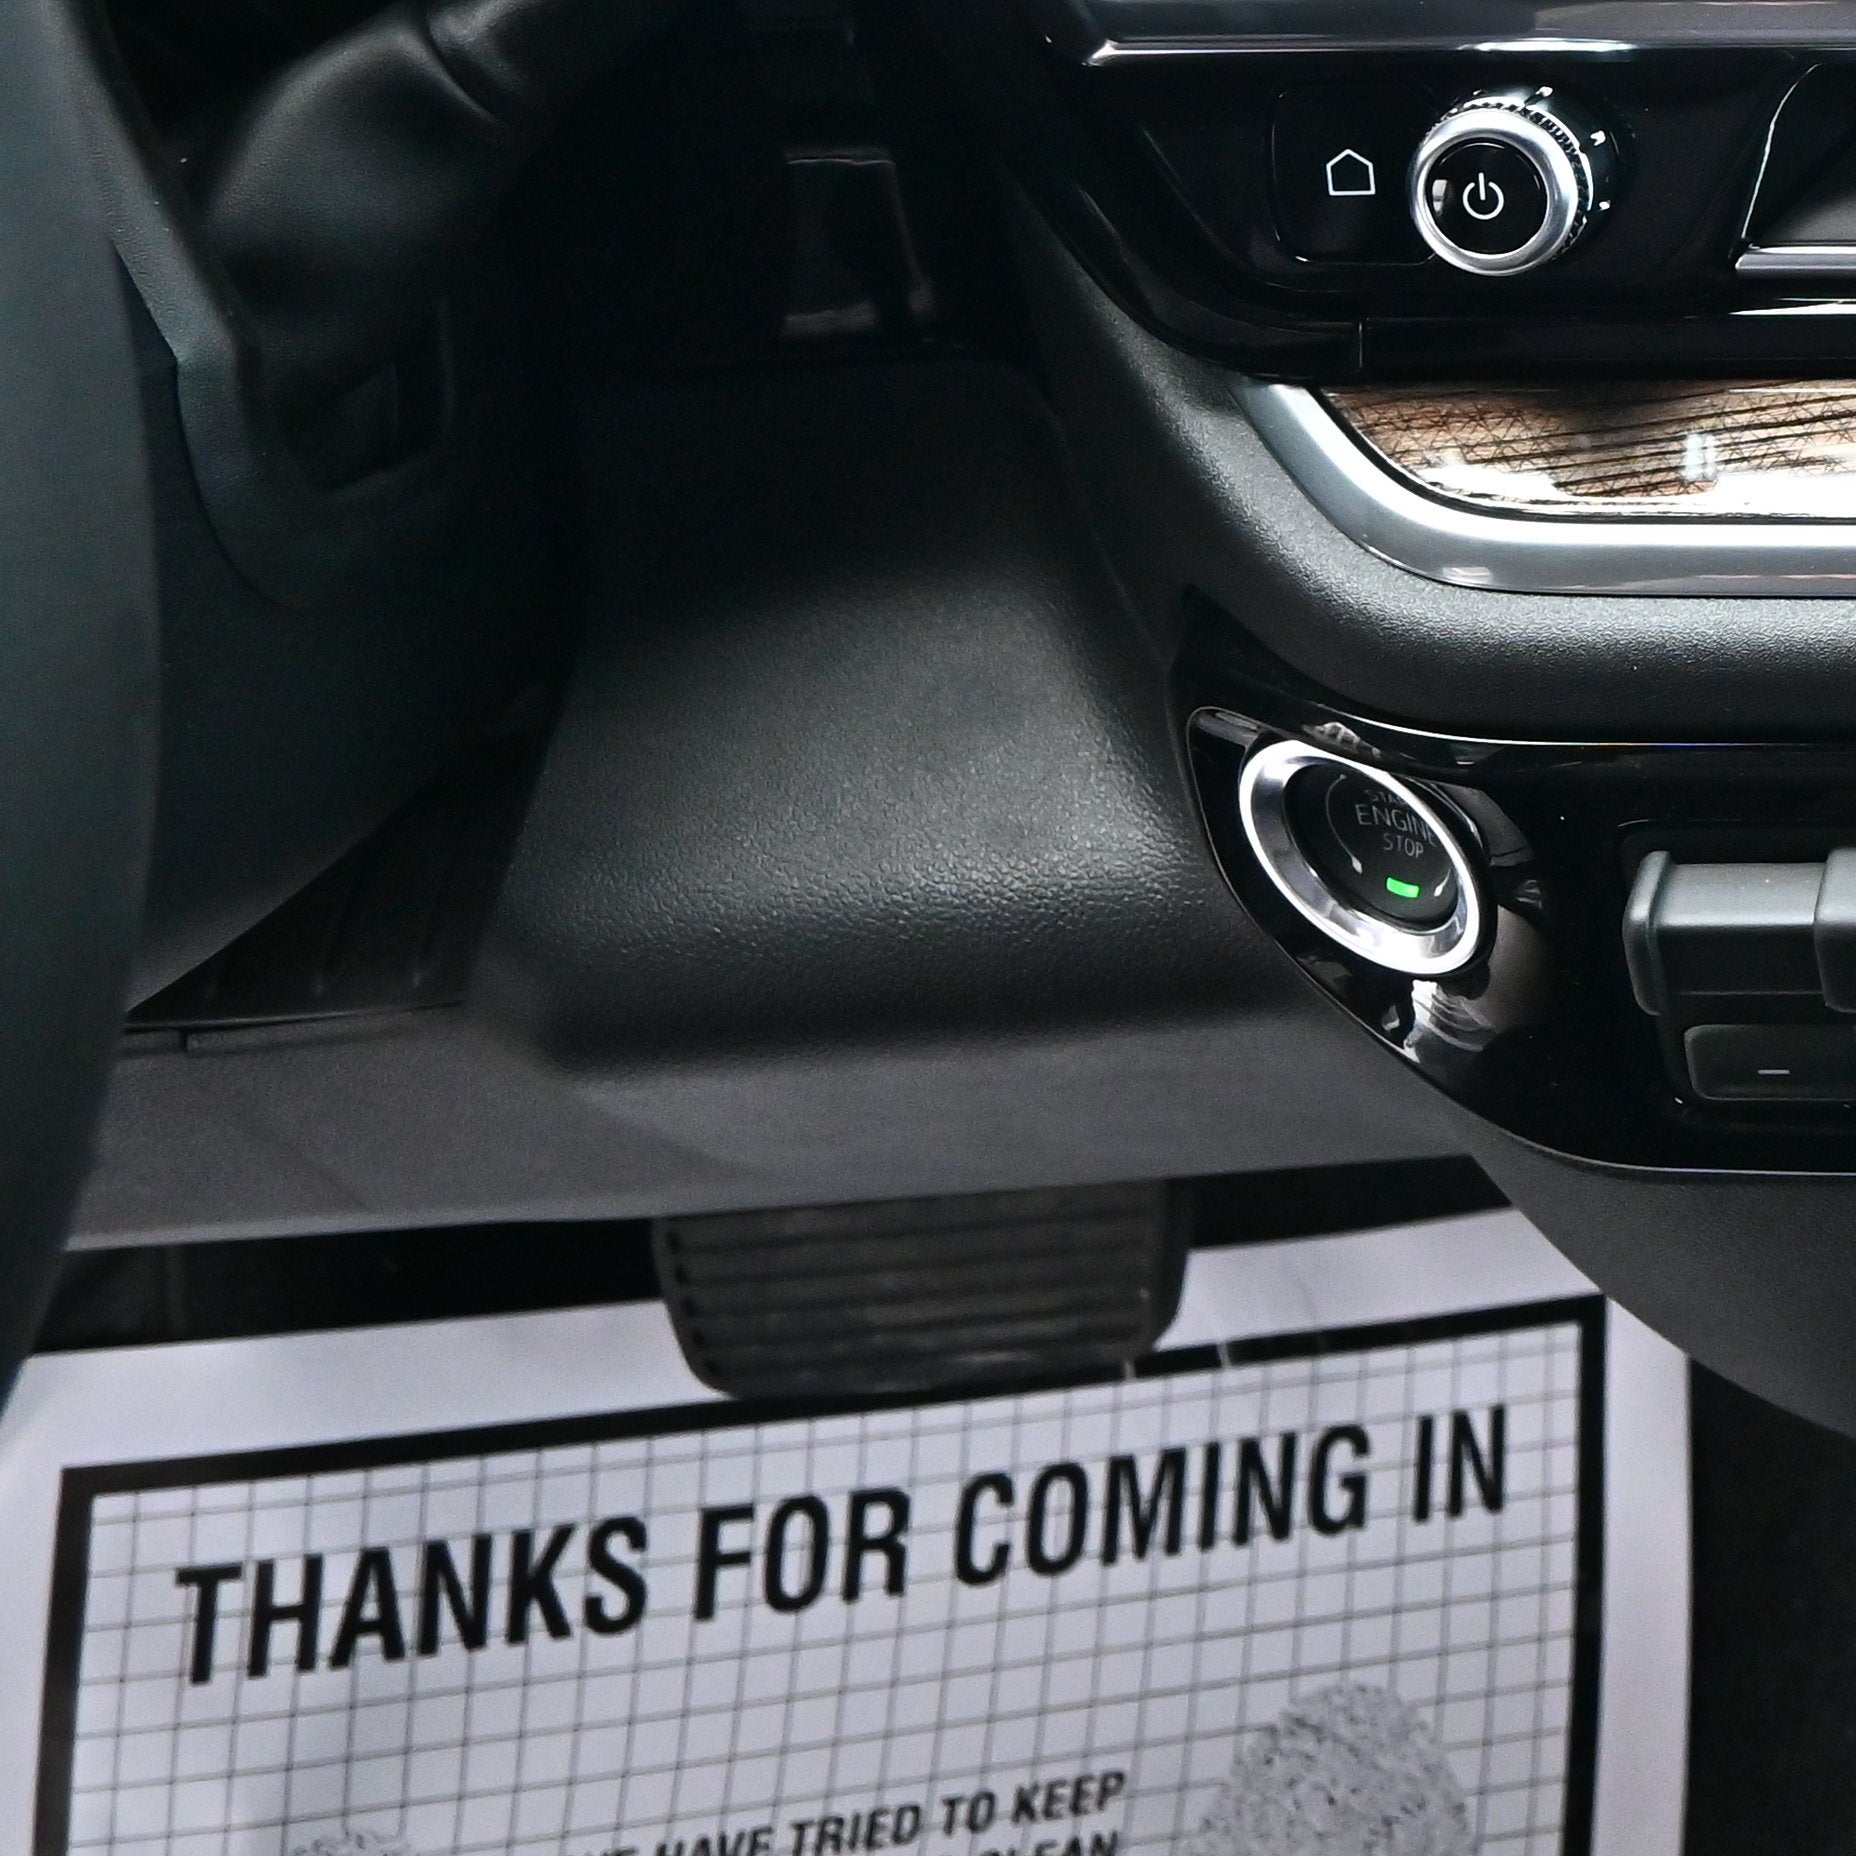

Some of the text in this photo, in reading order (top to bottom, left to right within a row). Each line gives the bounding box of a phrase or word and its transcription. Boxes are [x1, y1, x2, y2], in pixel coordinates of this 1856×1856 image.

[1382, 832, 1425, 859] STOP
[174, 1403, 1508, 1689] THANKS FOR COMING IN
[790, 1804, 922, 1856] TRIED
[942, 1791, 997, 1836] TO
[1010, 1770, 1128, 1826] KEEP
